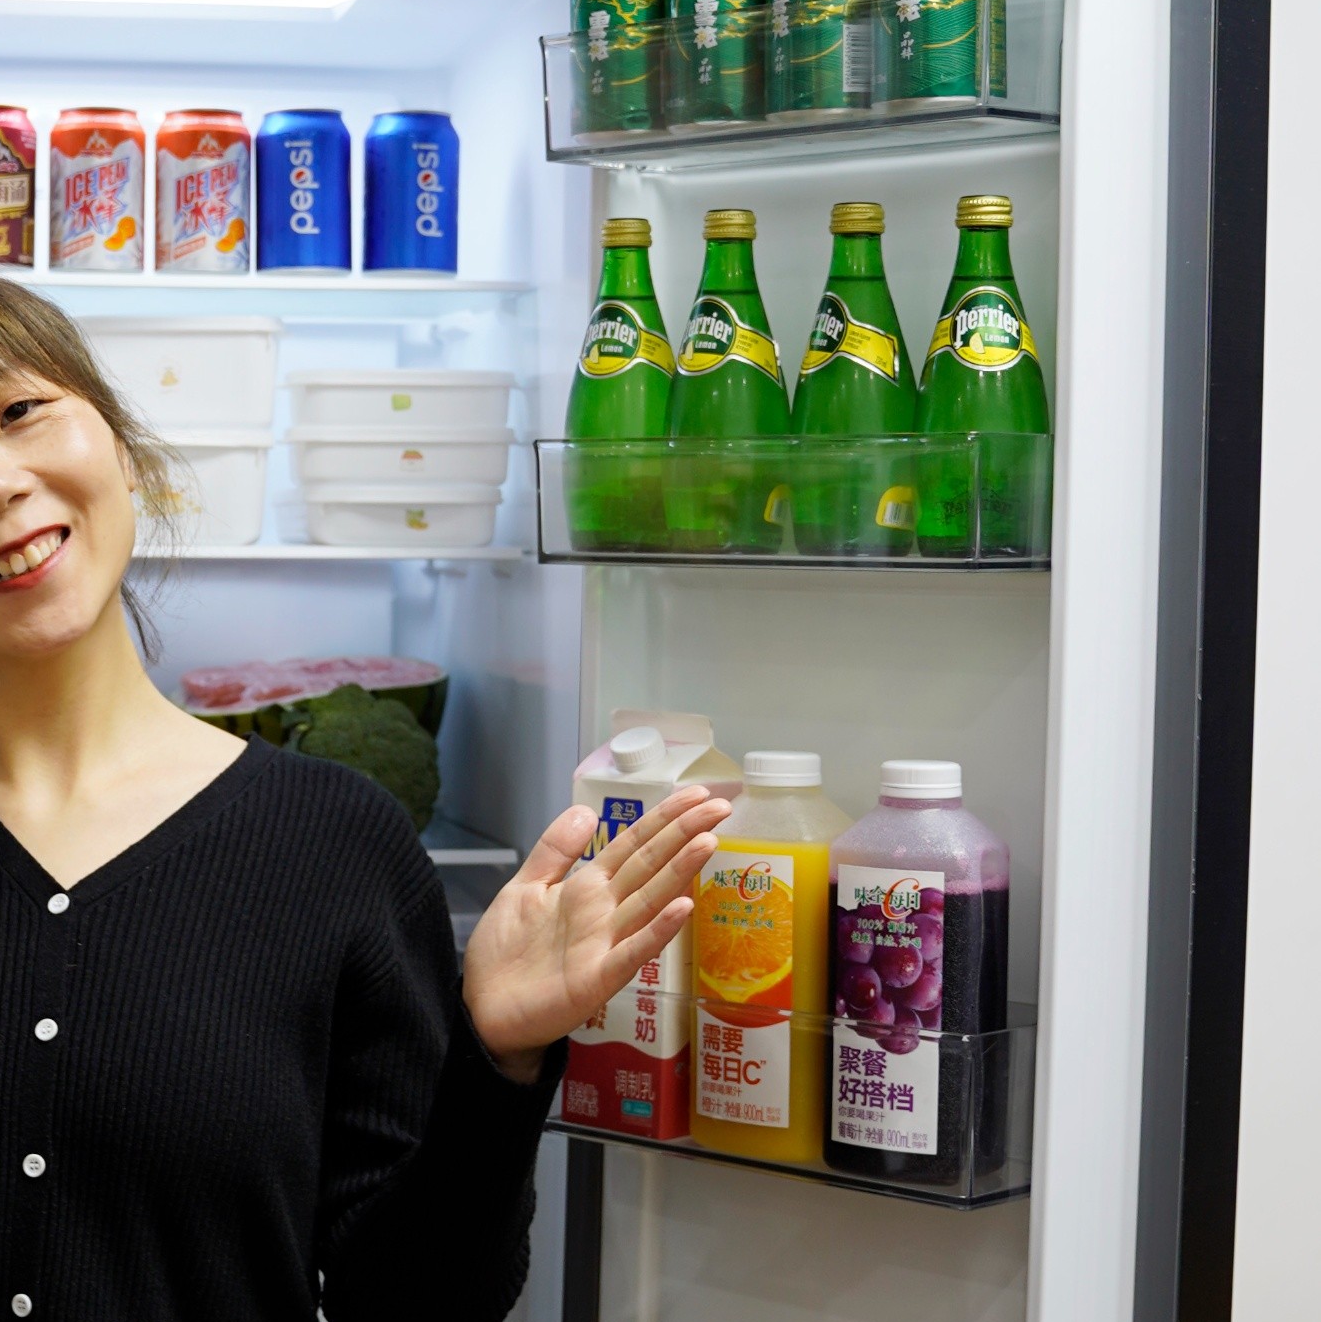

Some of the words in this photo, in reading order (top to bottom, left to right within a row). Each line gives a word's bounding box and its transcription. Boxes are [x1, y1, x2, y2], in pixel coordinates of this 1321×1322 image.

[284, 140, 321, 235] pepsi
[411, 142, 444, 238] pepsi
[953, 304, 1019, 349] perrier
[984, 333, 1009, 344] Lemon
[600, 343, 623, 353] Lemon
[694, 340, 717, 350] Lemon
[610, 801, 637, 820] 盒马
[857, 919, 884, 931] 100%
[635, 953, 661, 1043] 草莓奶
[702, 1023, 744, 1055] 需要
[839, 1045, 887, 1079] 聚餐
[838, 1075, 914, 1112] 好搭档
[838, 1106, 885, 1122] 你要喝果汁
